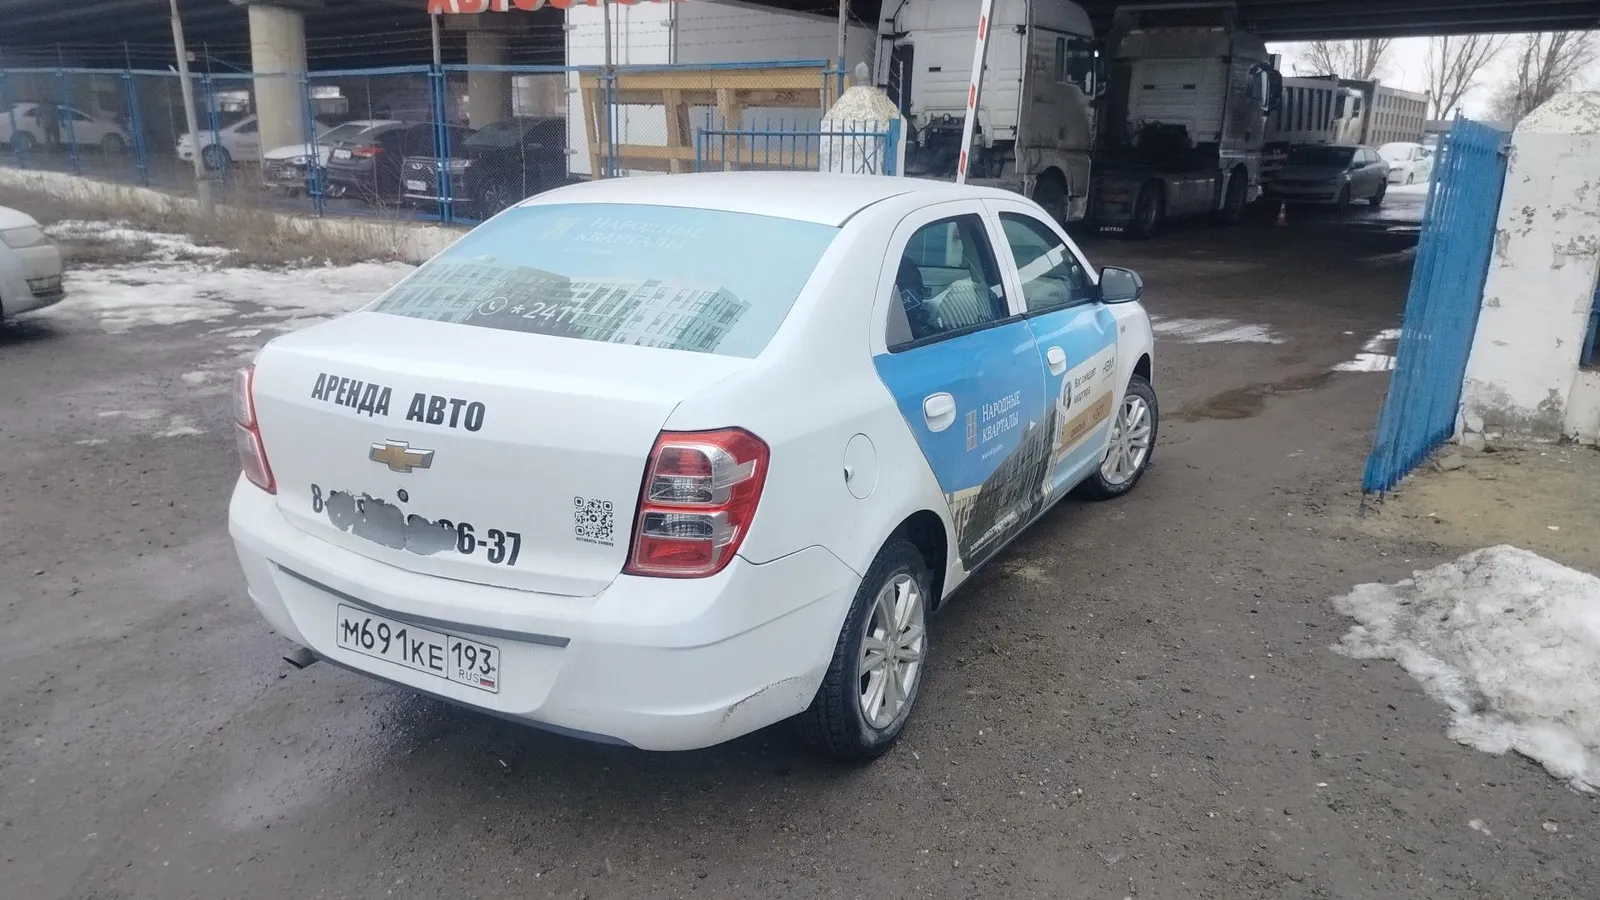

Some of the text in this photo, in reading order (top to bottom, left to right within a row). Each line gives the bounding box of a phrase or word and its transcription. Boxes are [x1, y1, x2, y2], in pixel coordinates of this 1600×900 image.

[311, 372, 486, 432] АРЕНДА АВТО
[982, 390, 1021, 423] НАРОДНЫЕ
[982, 410, 1019, 443] КВАРТАЛЫ
[343, 617, 492, 675] М691КЕ 193
[458, 669, 479, 683] RUS
